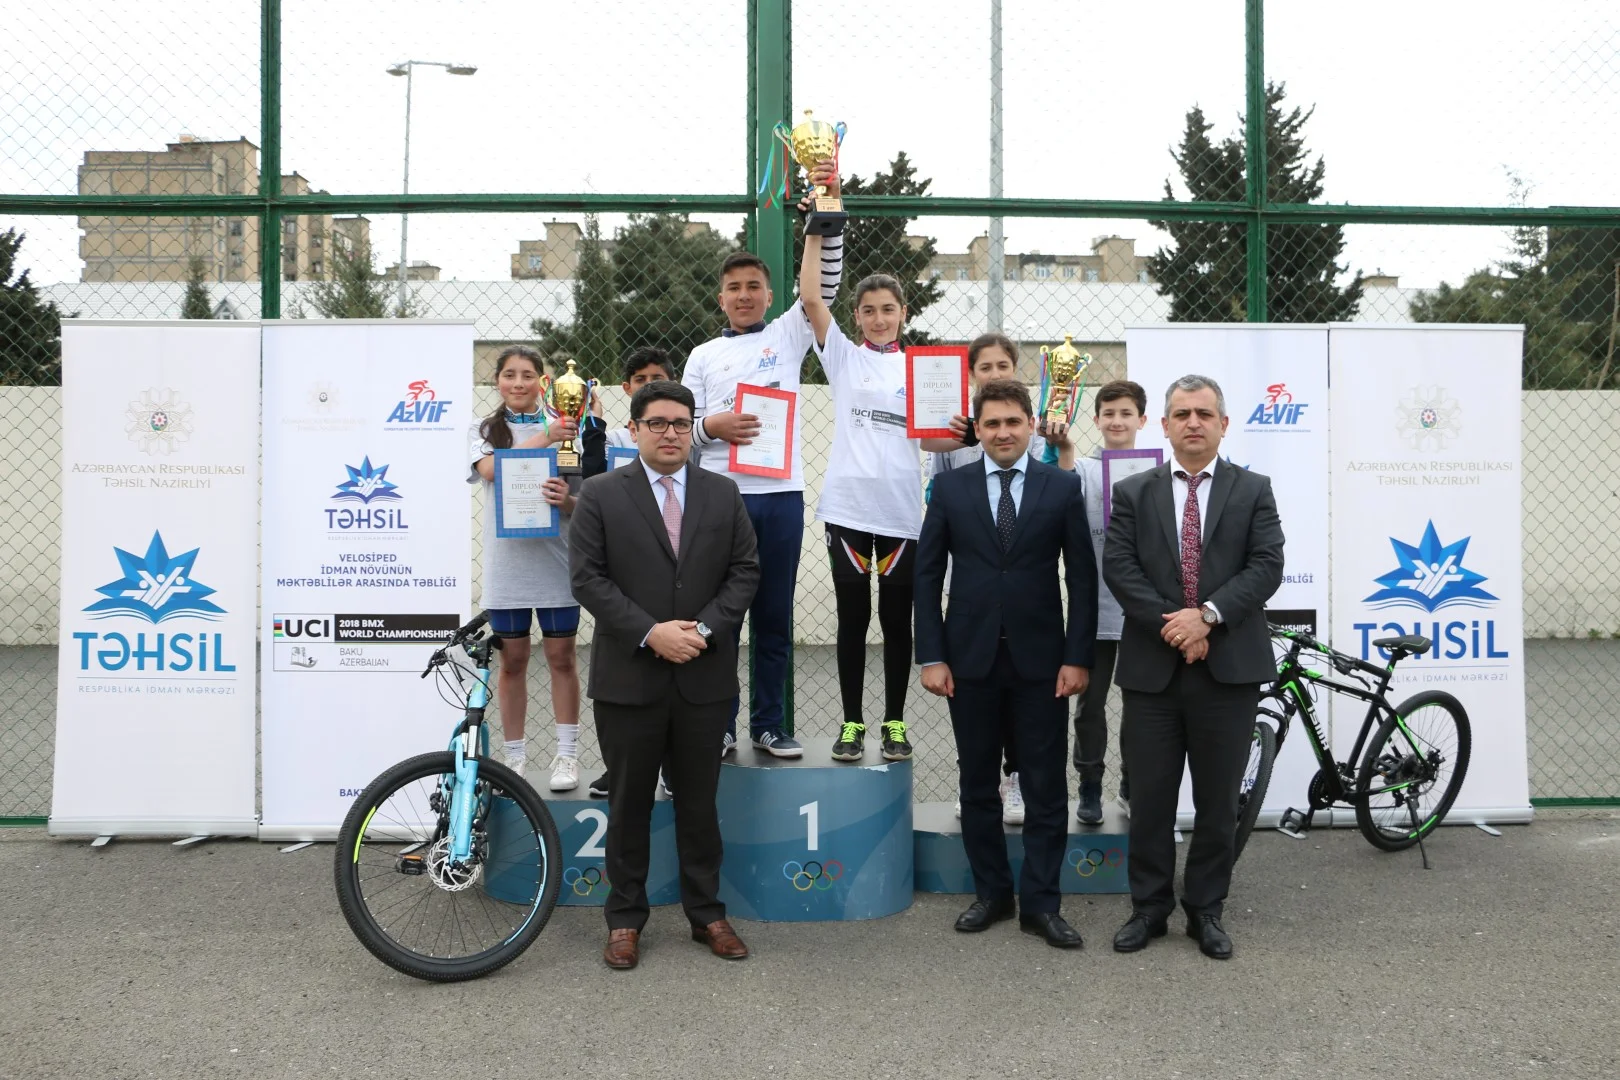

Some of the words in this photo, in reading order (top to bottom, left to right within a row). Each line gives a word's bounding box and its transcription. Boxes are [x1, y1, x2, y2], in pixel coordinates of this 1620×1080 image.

[855, 408, 871, 418] UCI
[72, 463, 156, 474] AZƏRBAYCAN
[339, 552, 397, 563] VELOSİPED
[320, 565, 357, 575] İDMAN
[360, 565, 412, 575] NÖVÜNÜN
[277, 577, 353, 587] MƏKTƏBLİLƏR
[356, 578, 410, 587] ARASINDA
[413, 576, 457, 588] TƏBLİĞİ
[285, 619, 329, 637] UCI
[339, 619, 359, 628] 2018
[361, 619, 384, 628] BMX
[339, 629, 372, 638] WORLD
[375, 629, 455, 639] CHAMPIONSHIPS
[339, 648, 363, 656] BAKU
[339, 658, 389, 666] AZERBAIJAN
[800, 800, 818, 850] 1
[575, 808, 608, 857] 2
